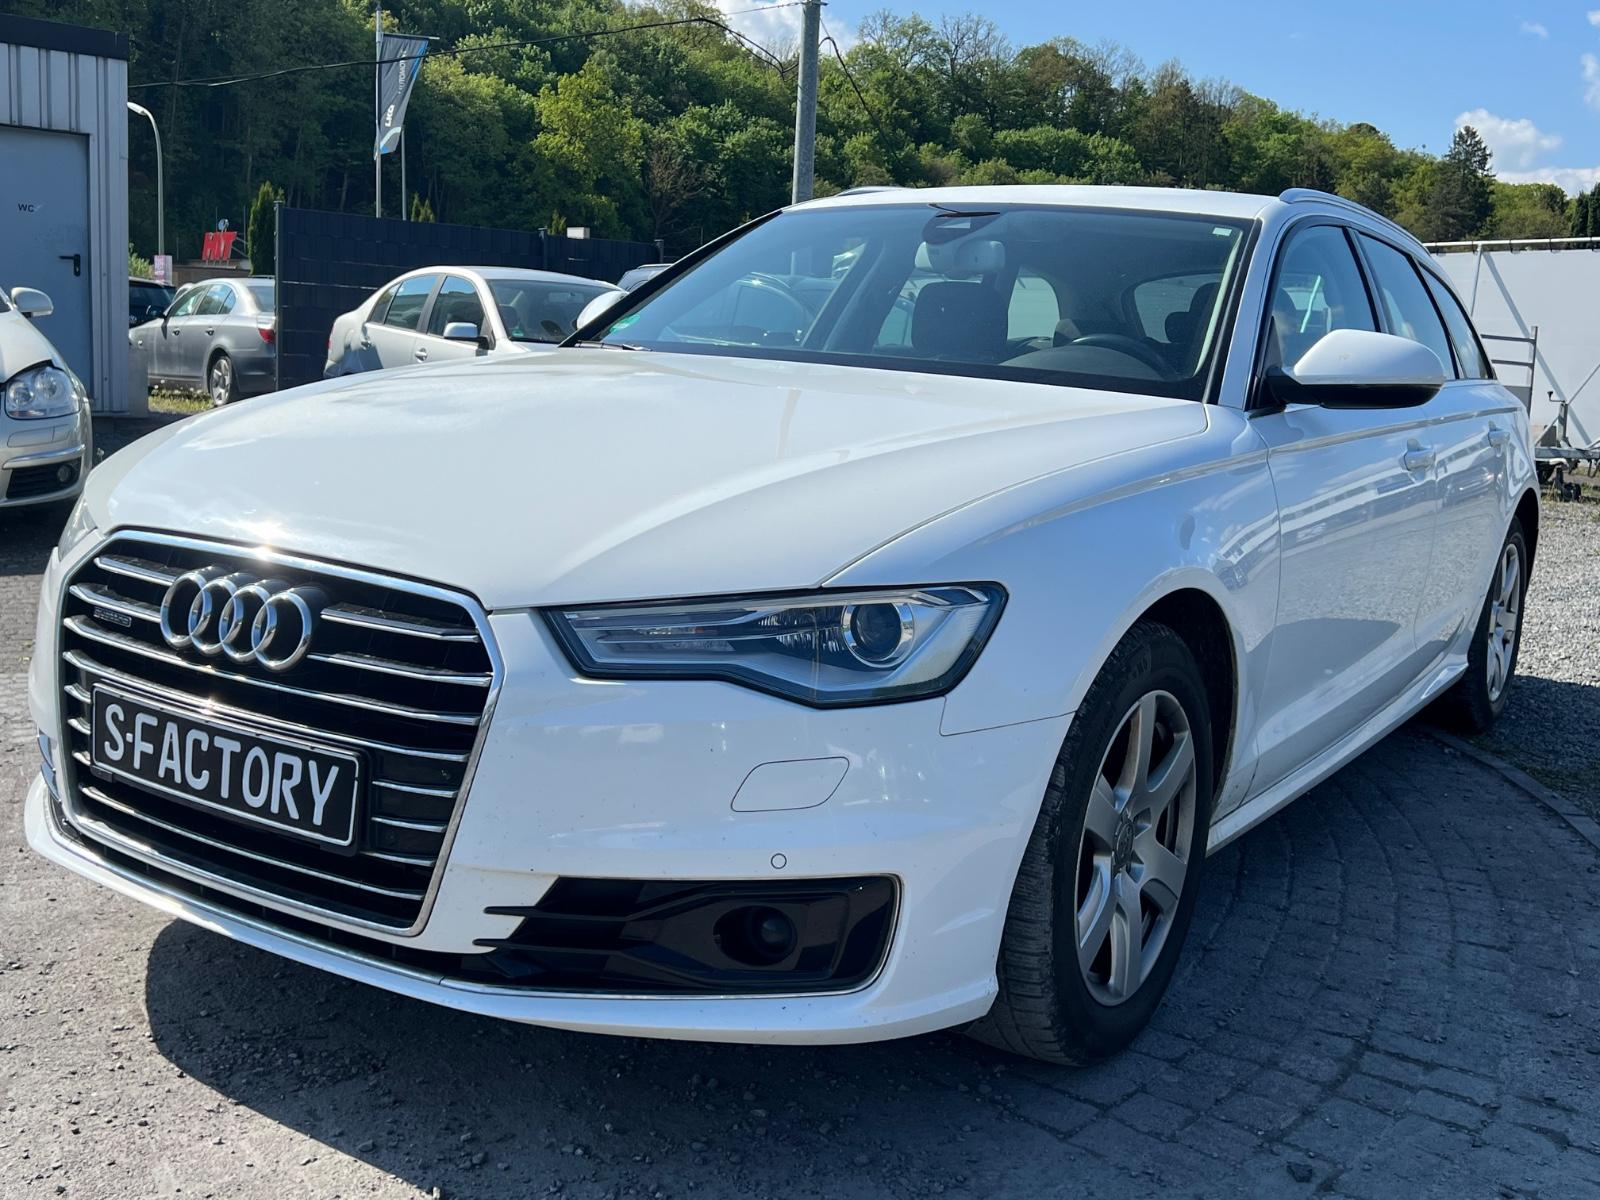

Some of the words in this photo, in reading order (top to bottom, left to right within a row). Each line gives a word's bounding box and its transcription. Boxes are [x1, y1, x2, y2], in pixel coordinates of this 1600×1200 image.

[17, 203, 35, 213] WC
[202, 231, 238, 261] HIT
[104, 703, 340, 827] S-FACTORY
